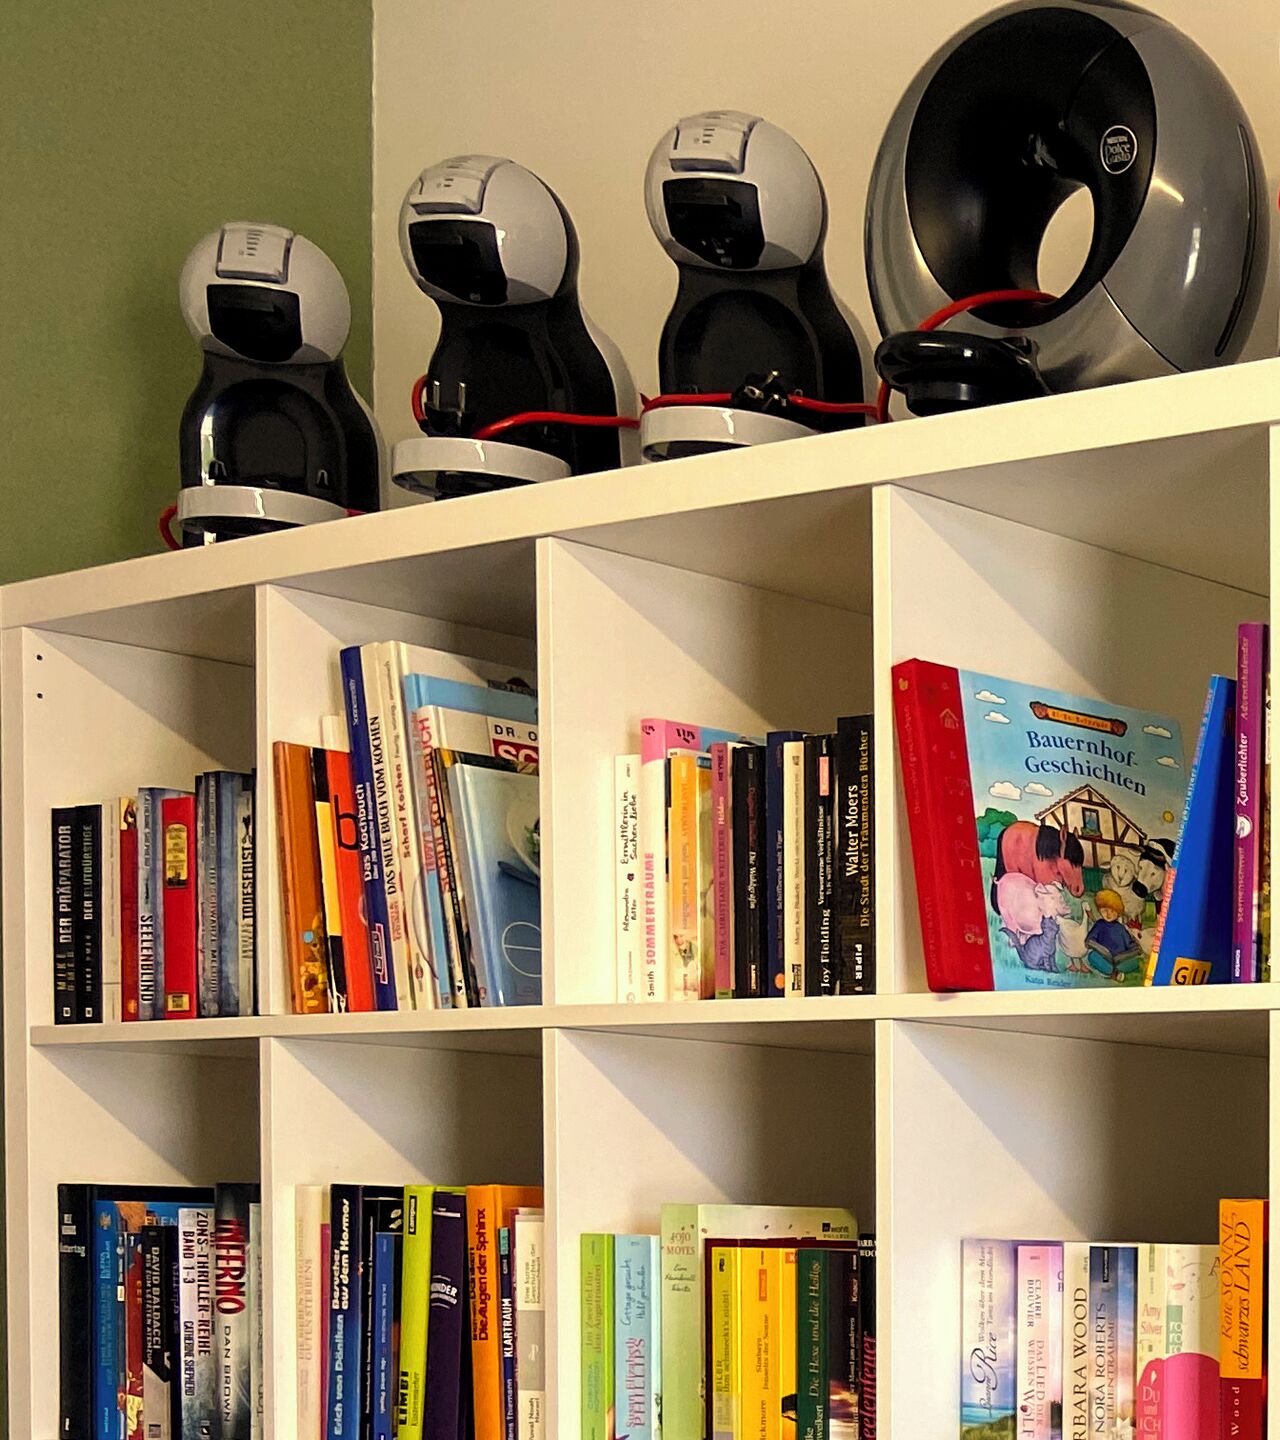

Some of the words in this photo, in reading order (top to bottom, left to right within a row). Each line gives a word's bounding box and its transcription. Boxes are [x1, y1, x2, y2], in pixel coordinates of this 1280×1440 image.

[369, 716, 385, 767] KOCHEN
[1023, 728, 1139, 768] Bauernhof-
[377, 772, 388, 798] VOM
[1022, 754, 1147, 797] Geschichten
[355, 784, 370, 851] Kochbuch
[379, 799, 392, 834] BUCH
[846, 784, 858, 828] Moers
[58, 825, 72, 913] PRÄPARATOR
[363, 855, 373, 882] Das
[381, 835, 394, 866] NEUE
[845, 833, 860, 877] Walter
[386, 866, 397, 895] DAS
[59, 918, 72, 943] DER
[645, 852, 656, 965] SOMMERTRÄUME
[140, 915, 154, 1004] SEELENBLIND
[151, 1246, 160, 1284] DAVID
[151, 1288, 162, 1350] BALDACCI
[503, 1298, 513, 1358] KLARTRAUM
[1073, 1287, 1088, 1361] WOOD
[224, 1326, 232, 1359] DAN
[335, 1314, 344, 1371] Däniken
[1095, 1303, 1107, 1383] ROBERTS
[223, 1365, 232, 1422] BROWN
[1094, 1385, 1106, 1434] NORA
[334, 1399, 343, 1436] Erich
